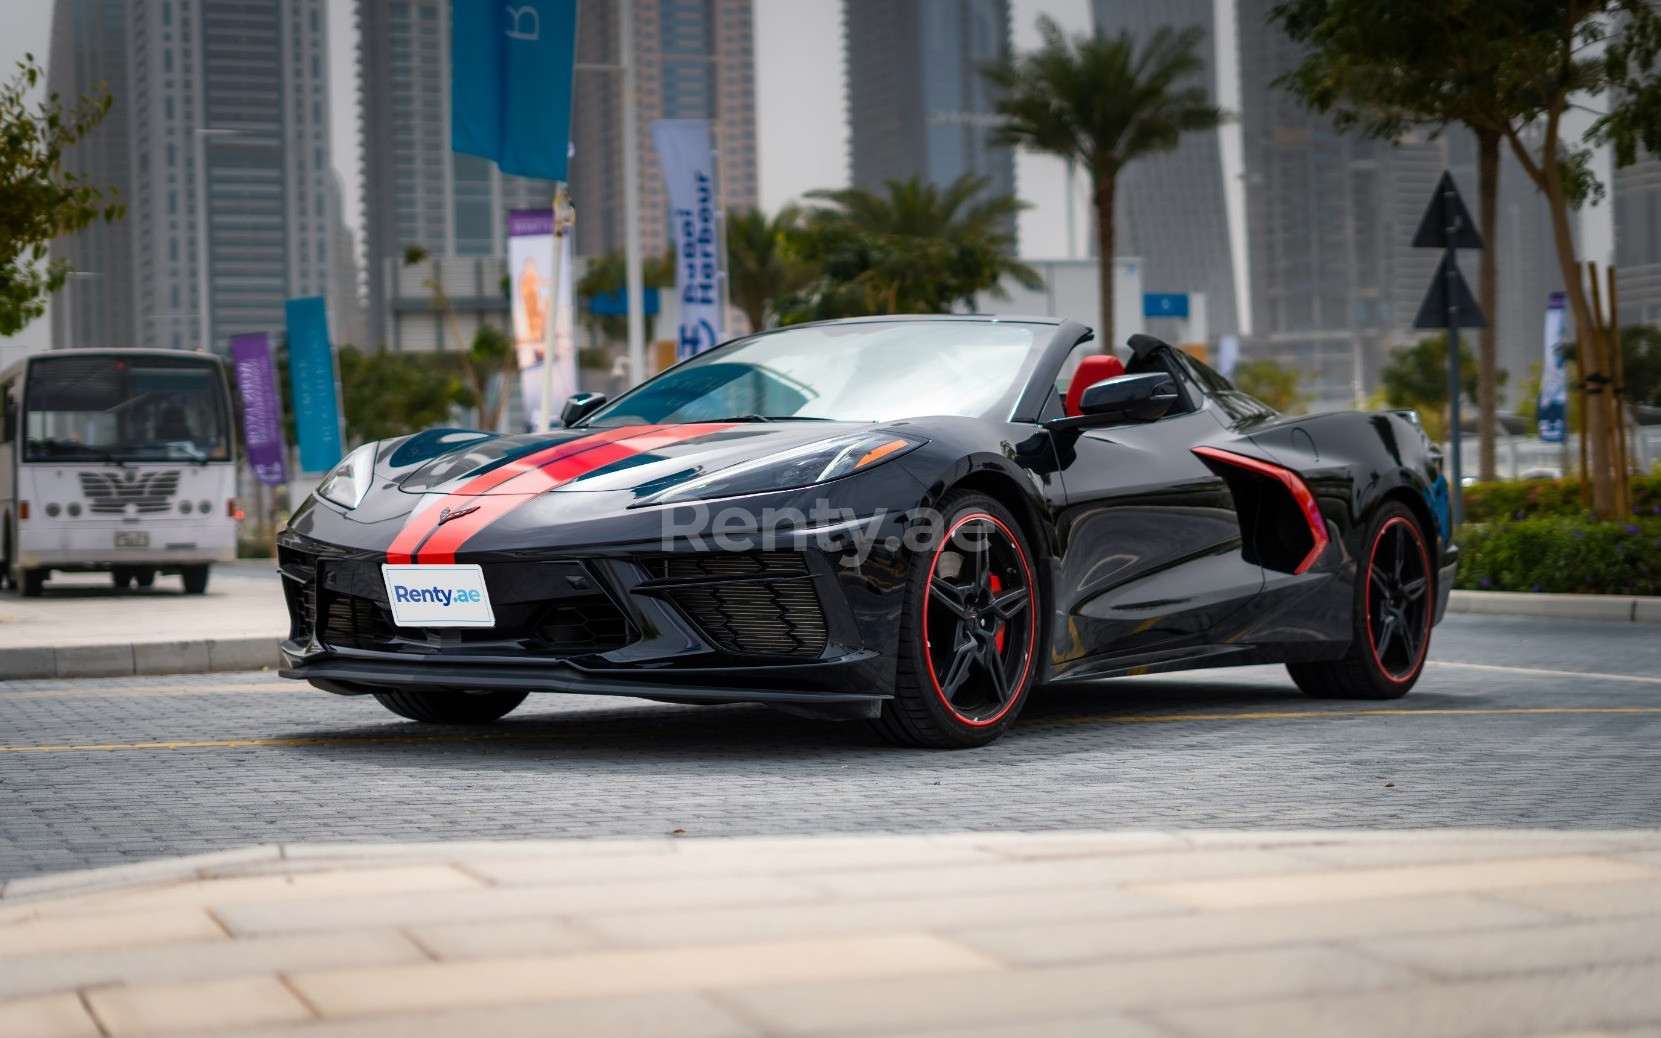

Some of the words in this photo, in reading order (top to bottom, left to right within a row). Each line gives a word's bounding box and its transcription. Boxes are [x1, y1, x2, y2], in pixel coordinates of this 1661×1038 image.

[675, 209, 697, 303] Dubai
[696, 168, 714, 304] Harbour
[394, 585, 480, 606] Renty.ae
